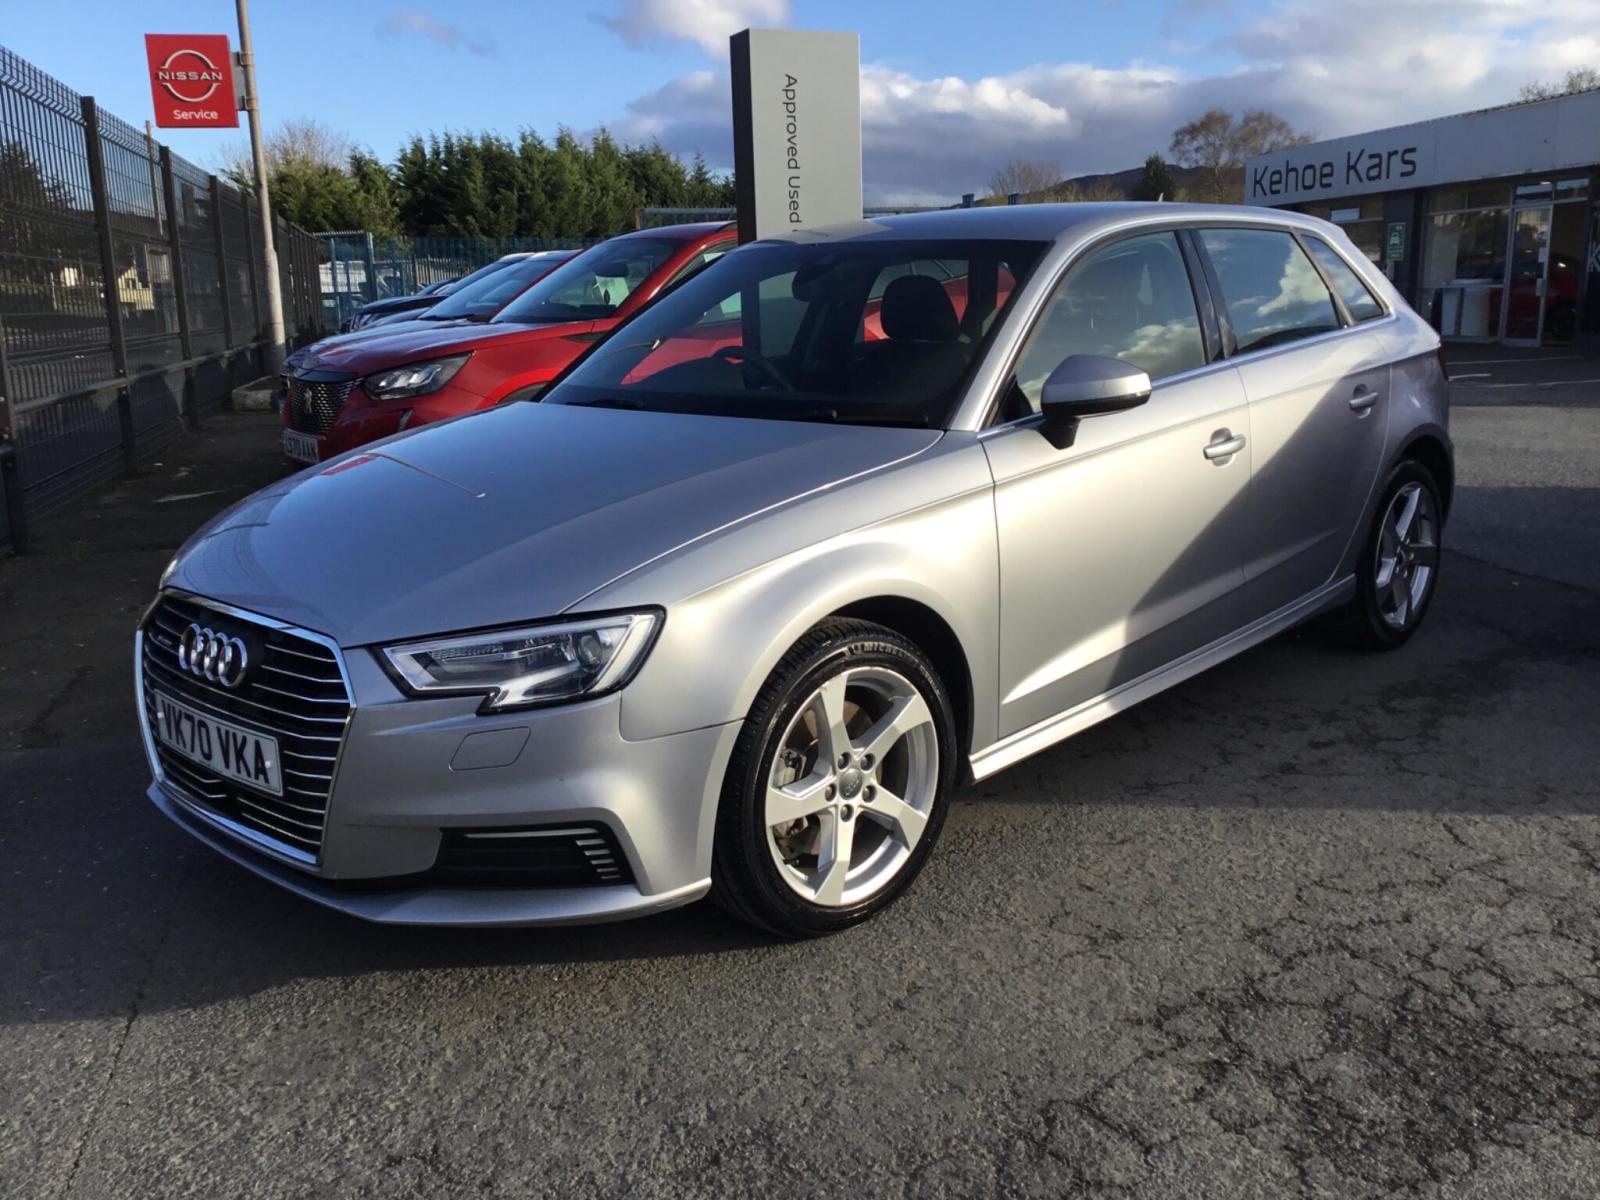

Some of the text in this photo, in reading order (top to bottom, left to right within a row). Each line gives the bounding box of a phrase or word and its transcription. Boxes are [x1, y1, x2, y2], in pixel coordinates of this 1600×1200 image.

[158, 71, 222, 80] NISSAN
[173, 109, 218, 120] Service
[782, 73, 800, 169] Approved
[1253, 147, 1417, 197] Kehoe Kars
[788, 176, 802, 223] Used
[161, 699, 270, 784] VK70 VKA
